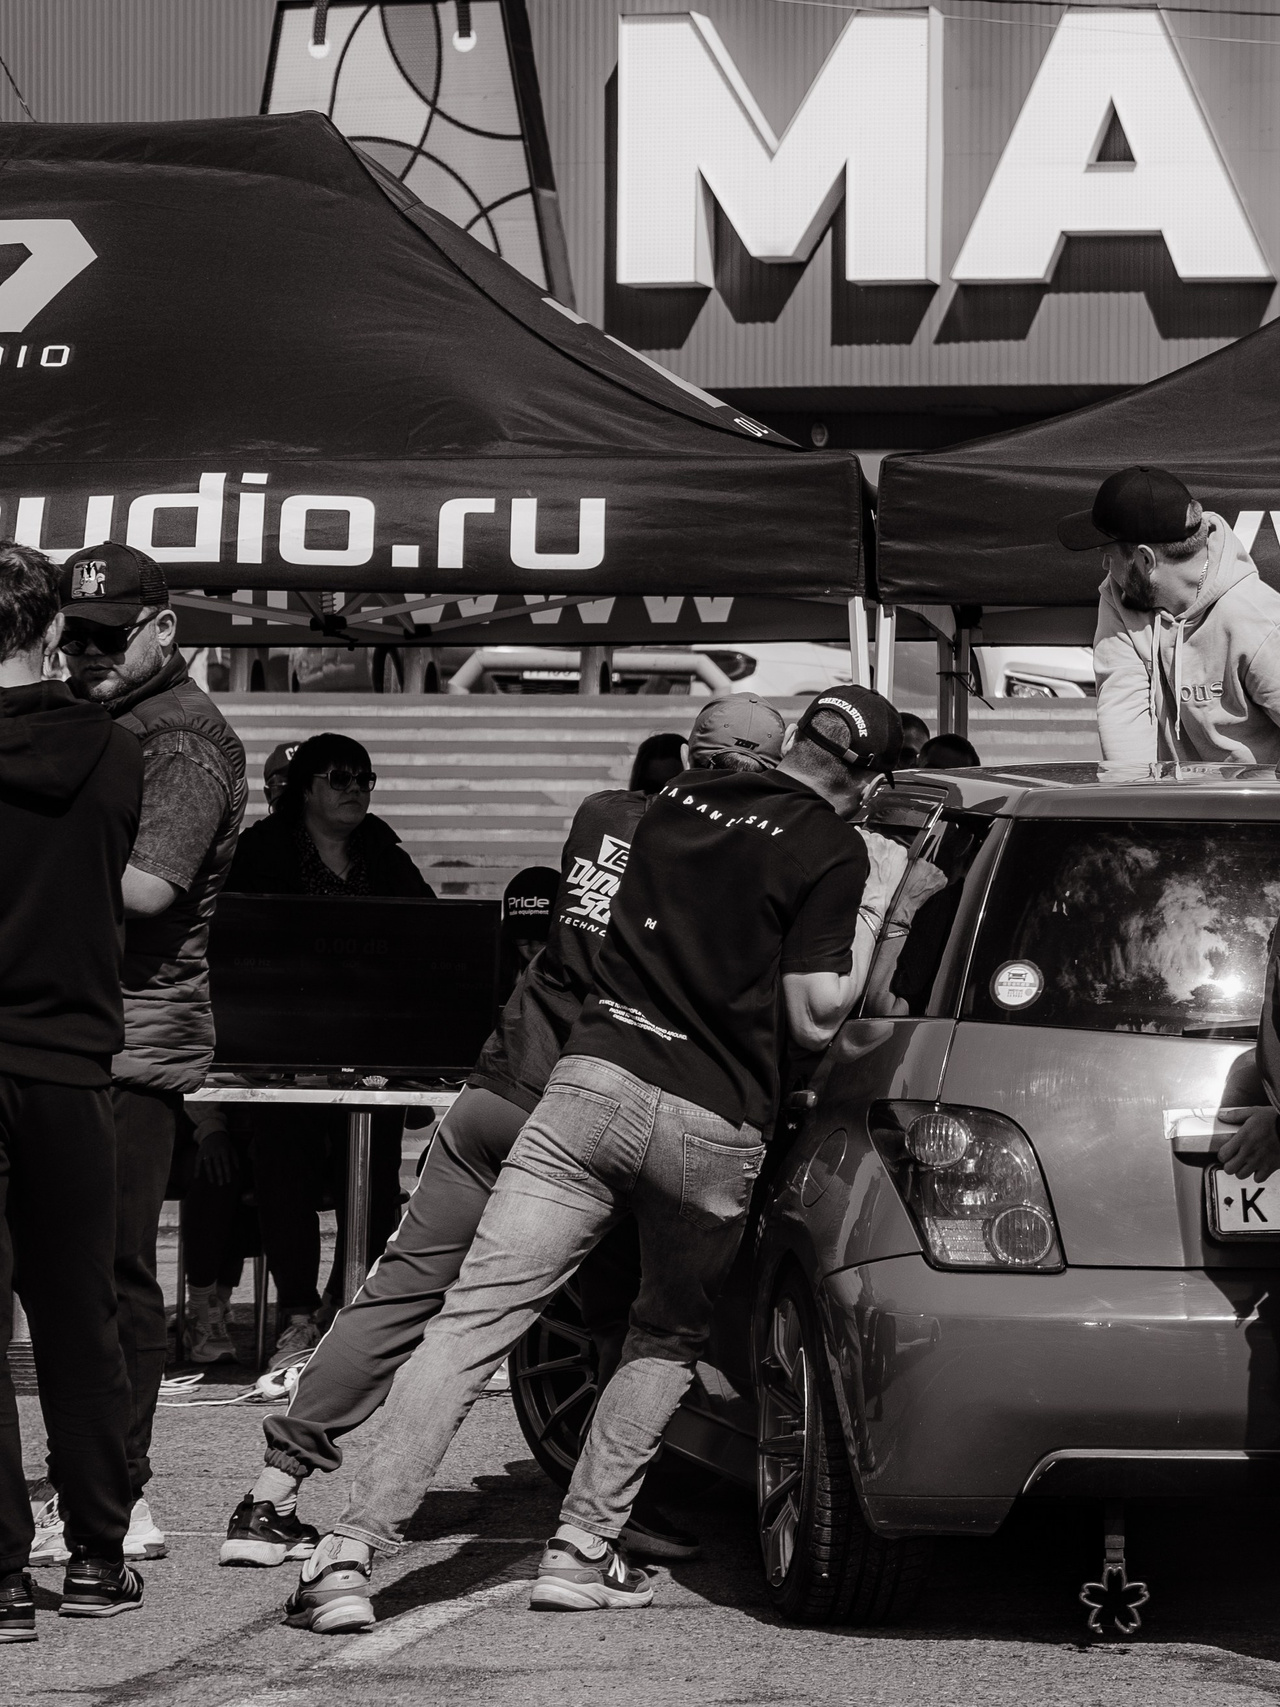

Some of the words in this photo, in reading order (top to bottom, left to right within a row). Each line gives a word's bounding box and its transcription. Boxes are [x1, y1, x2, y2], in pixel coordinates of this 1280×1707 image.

[0, 345, 70, 368] IO
[14, 472, 607, 569] udio.ru
[1180, 680, 1224, 703] ous
[817, 697, 868, 738] CHELYABINSK
[566, 856, 621, 897] Dyn
[508, 896, 550, 909] Pride
[566, 891, 611, 925] St
